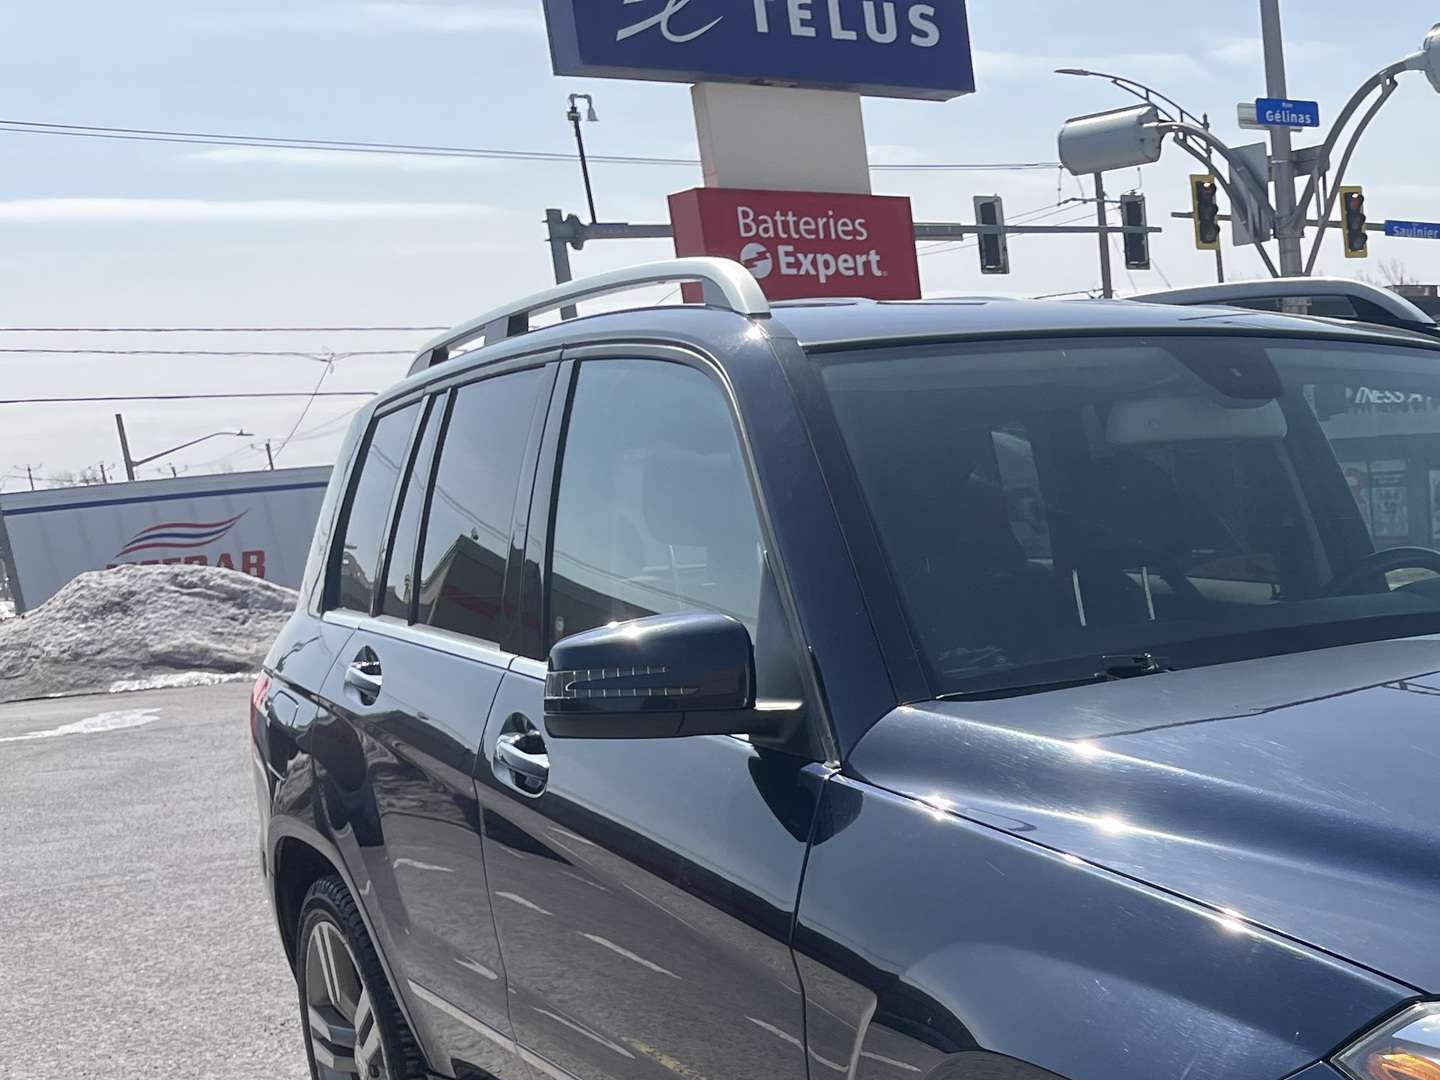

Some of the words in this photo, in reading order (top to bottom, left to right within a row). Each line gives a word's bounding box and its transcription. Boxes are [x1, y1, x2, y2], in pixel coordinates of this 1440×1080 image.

[753, 0, 940, 48] TELUS
[1265, 109, 1312, 124] Gélinas
[736, 206, 868, 241] Batteries
[1393, 225, 1439, 238] Saulnier
[777, 244, 883, 283] Expert
